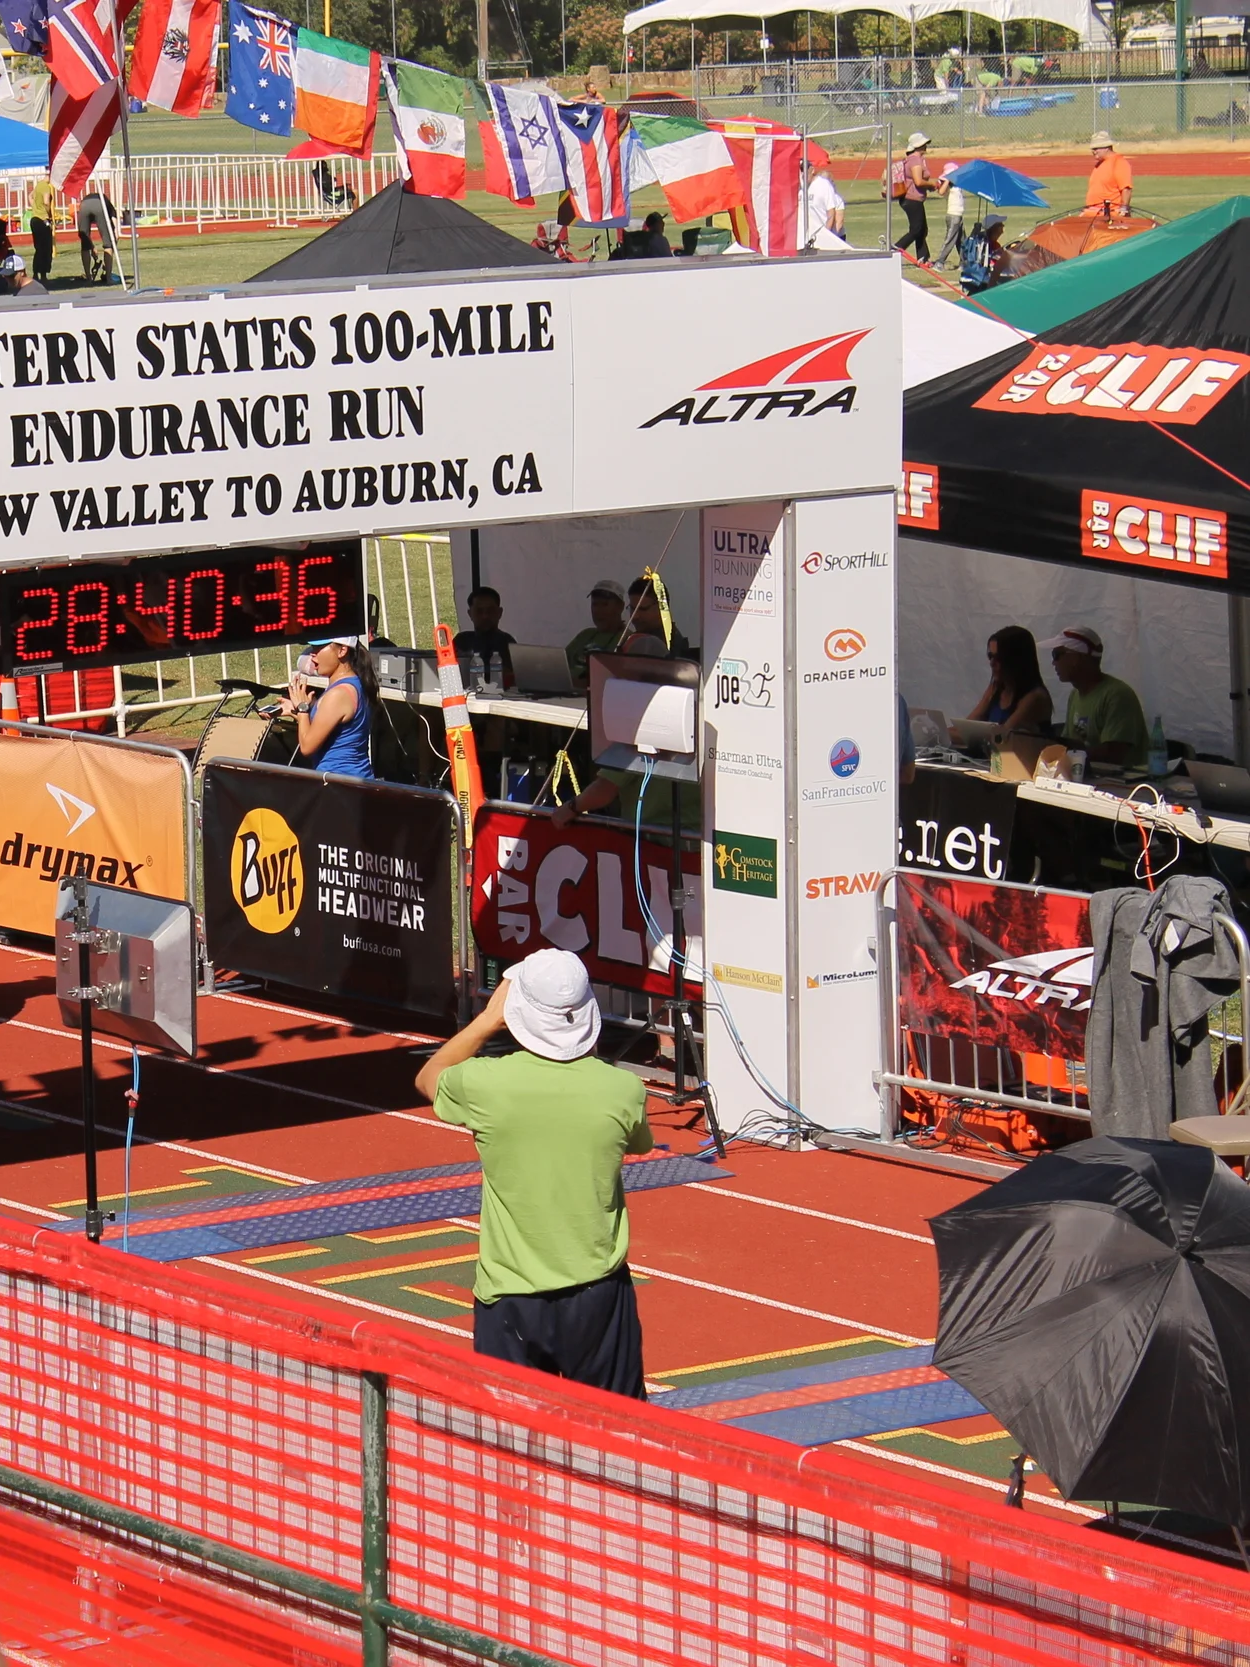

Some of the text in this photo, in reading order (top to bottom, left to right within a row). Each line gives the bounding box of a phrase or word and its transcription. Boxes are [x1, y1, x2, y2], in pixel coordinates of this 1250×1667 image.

[137, 315, 316, 381] STATES
[328, 301, 556, 366] 100-MILE
[999, 353, 1071, 404] BAR
[1045, 352, 1241, 413] CLIF
[10, 385, 426, 468] ENDURANCE RUN
[636, 385, 857, 430] ALTRA
[50, 477, 214, 534] VALLEY
[225, 472, 283, 519] TO
[292, 457, 480, 514] AUBURN,
[491, 451, 544, 496] CA
[713, 530, 772, 556] ULTRA
[1091, 499, 1111, 549] BAR
[1113, 504, 1223, 567] CLIF
[713, 558, 773, 579] RUNNING
[823, 551, 889, 572] SPORTHILL
[713, 584, 773, 604] magazine
[714, 665, 740, 709] joe
[721, 661, 740, 676] ACTIVE
[803, 666, 887, 684] ORANGE MUD
[708, 747, 783, 769] Sharman Ultra
[717, 765, 773, 781] Endurance Coaching
[802, 780, 887, 801] SanFranciscoVC
[0, 832, 144, 889] drymax
[317, 843, 424, 882] THE ORIGINAL
[899, 818, 1003, 880] .net
[317, 867, 425, 902] MULTIFUNCTIONAL
[497, 835, 531, 945] BAR
[317, 886, 425, 932] HEADWEAR
[343, 934, 402, 958] buffusa.com
[725, 968, 751, 981] Hanson
[751, 972, 781, 987] McClain
